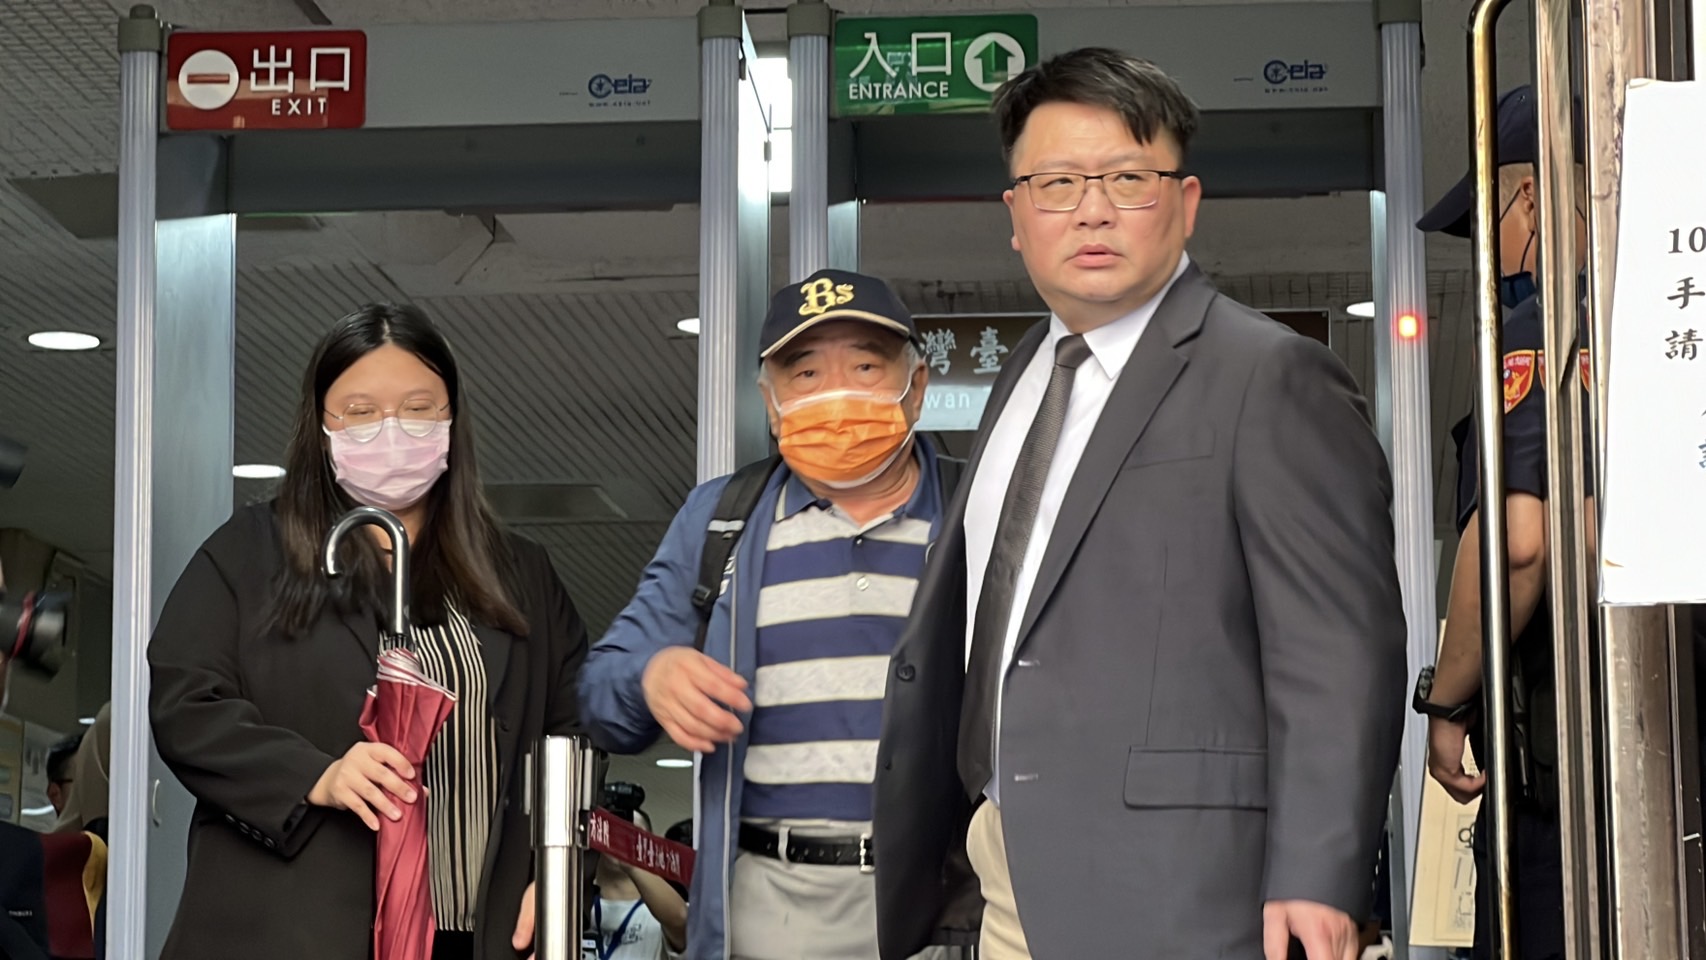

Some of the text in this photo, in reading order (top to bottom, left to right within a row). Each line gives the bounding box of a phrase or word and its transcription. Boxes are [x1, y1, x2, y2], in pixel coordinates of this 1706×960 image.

[250, 45, 349, 93] 出口
[849, 32, 951, 78] 入口
[849, 80, 949, 99] ENTRANCE
[271, 98, 327, 115] EXIT
[798, 277, 855, 316] Bs
[1667, 277, 1705, 310] 手
[1664, 328, 1703, 361] 請
